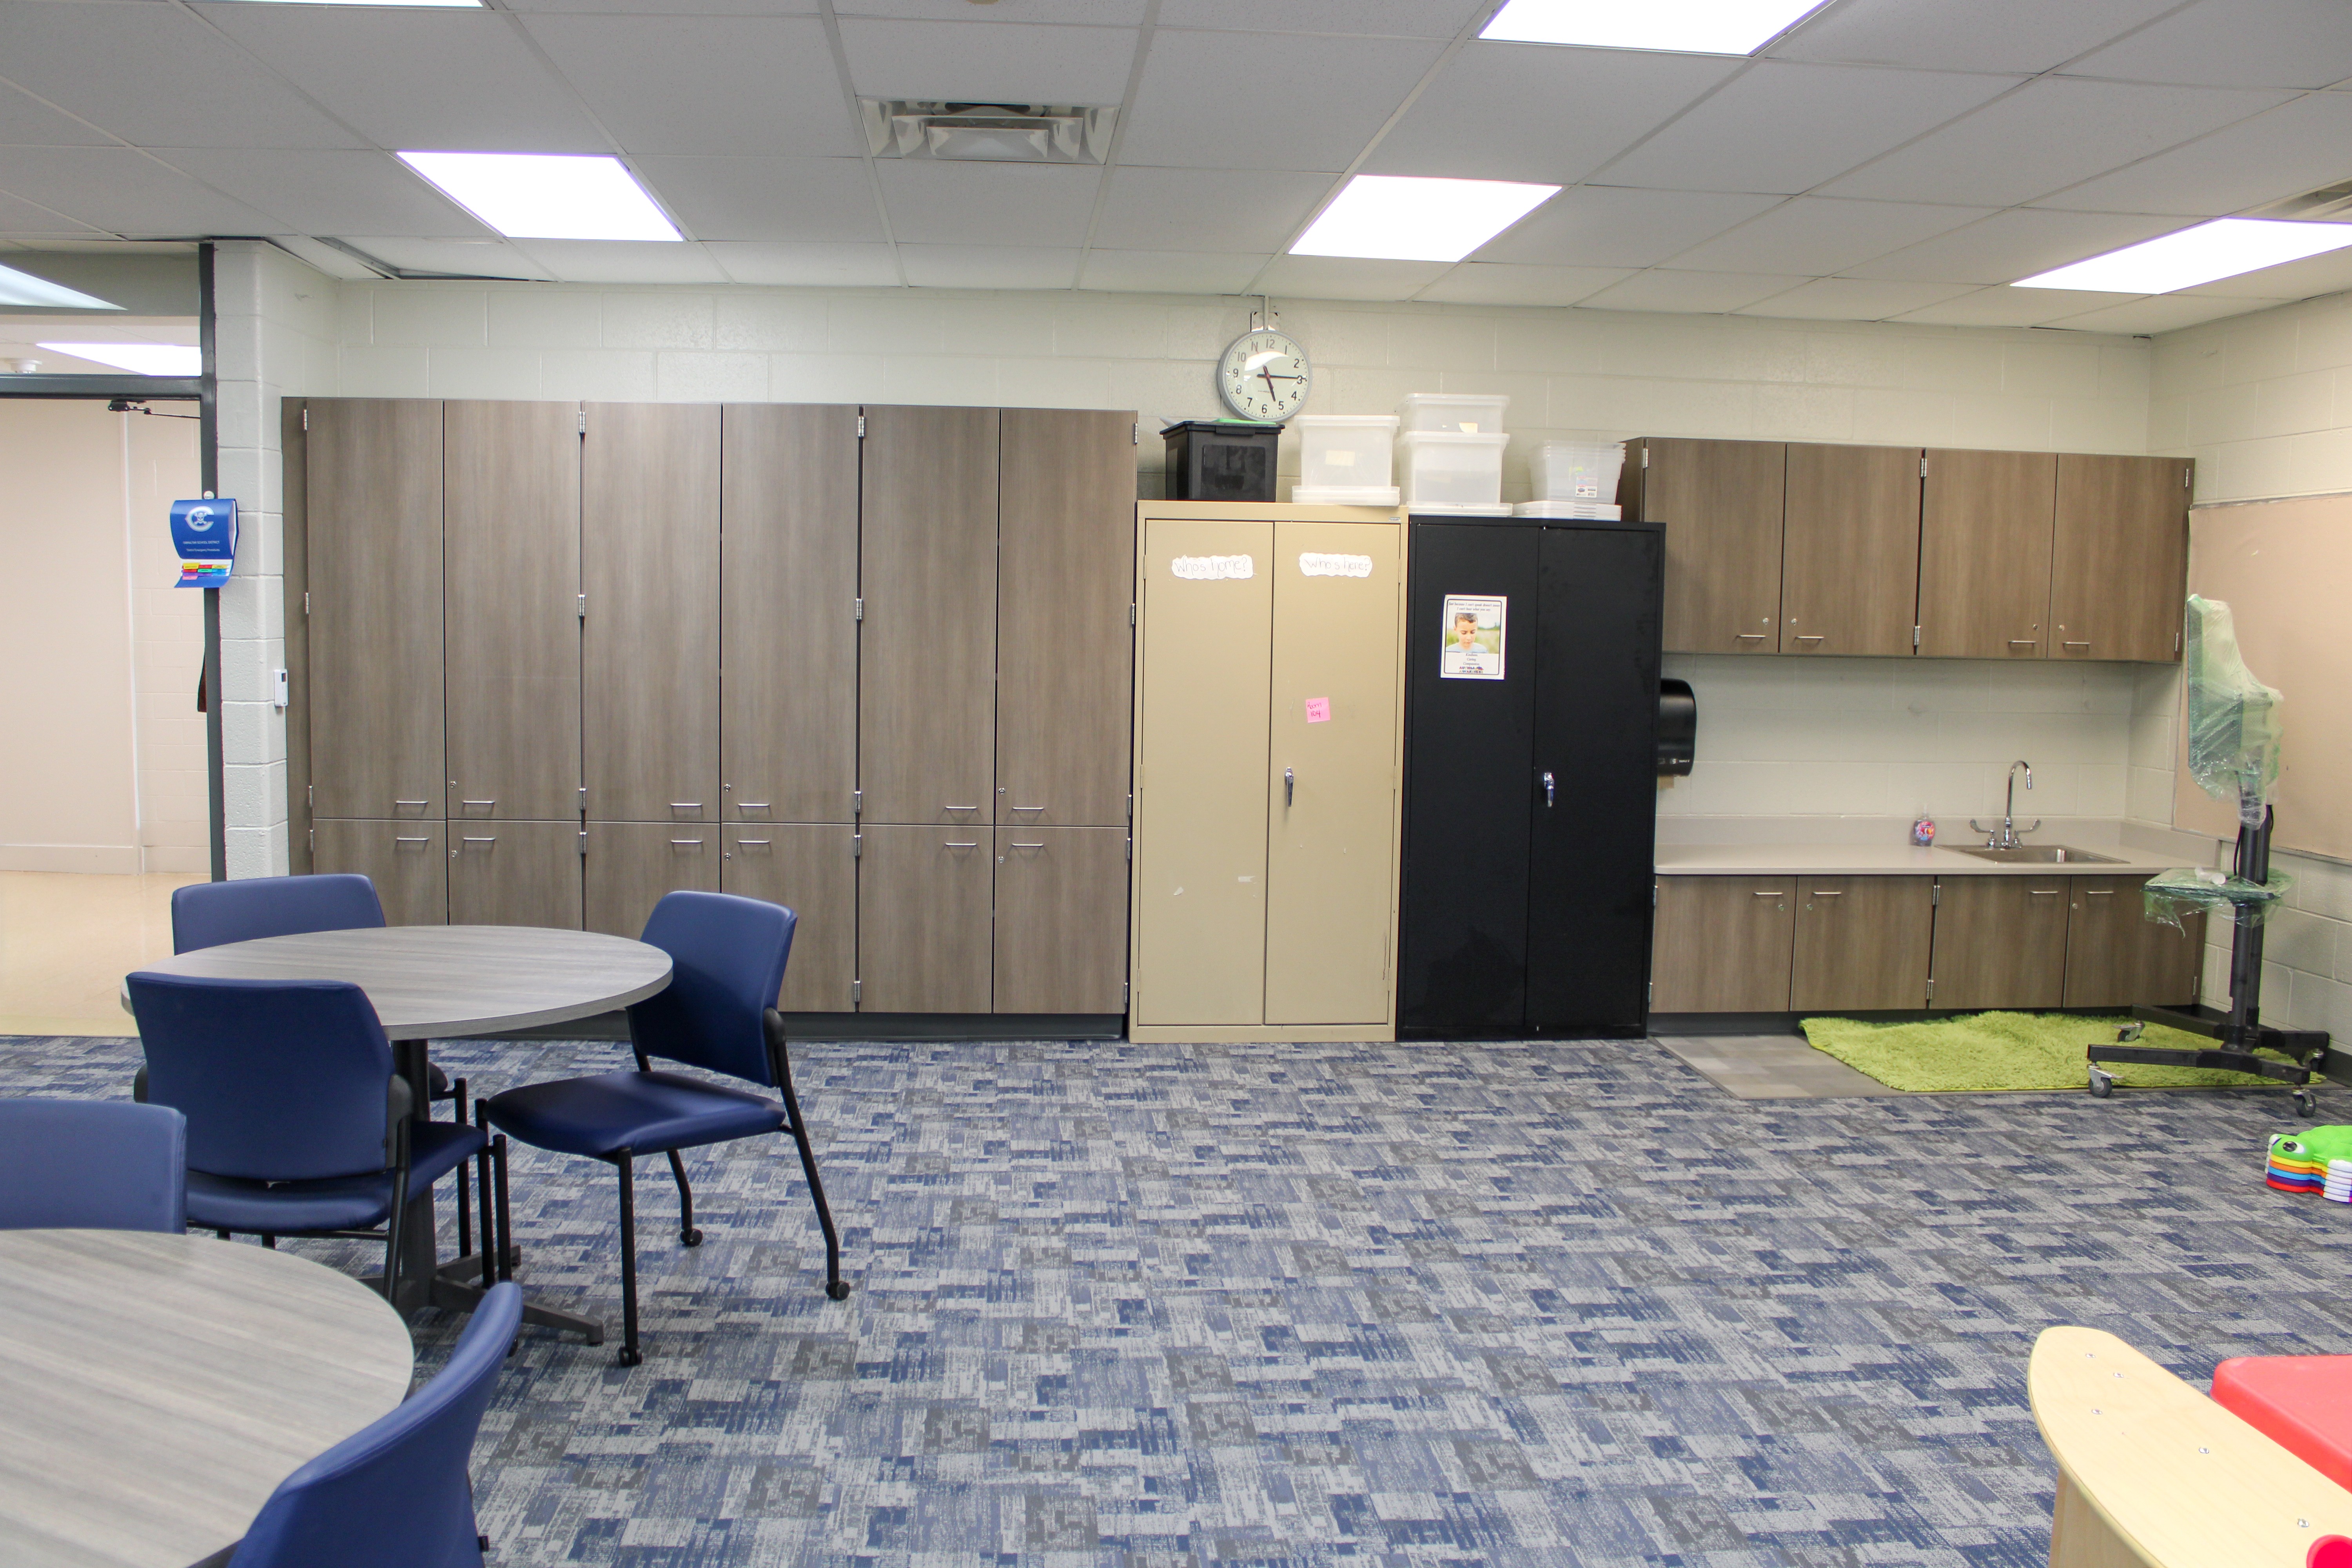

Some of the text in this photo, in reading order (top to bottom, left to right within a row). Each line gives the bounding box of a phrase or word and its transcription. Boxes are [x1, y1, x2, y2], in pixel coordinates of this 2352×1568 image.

[1251, 341, 1258, 352] 11
[1266, 338, 1275, 349] 12
[1284, 345, 1288, 355] 1
[1238, 352, 1247, 362] 10
[1294, 358, 1300, 369] 2
[1233, 368, 1239, 378] 9
[1297, 375, 1303, 385] 3
[1236, 385, 1242, 394] 8
[1291, 391, 1298, 401] 4
[1247, 397, 1253, 408] 7
[1278, 401, 1285, 411] 5
[1261, 404, 1267, 414] 6
[1210, 557, 1247, 578] home?
[1344, 557, 1371, 572] here?
[1310, 709, 1321, 719] 104
